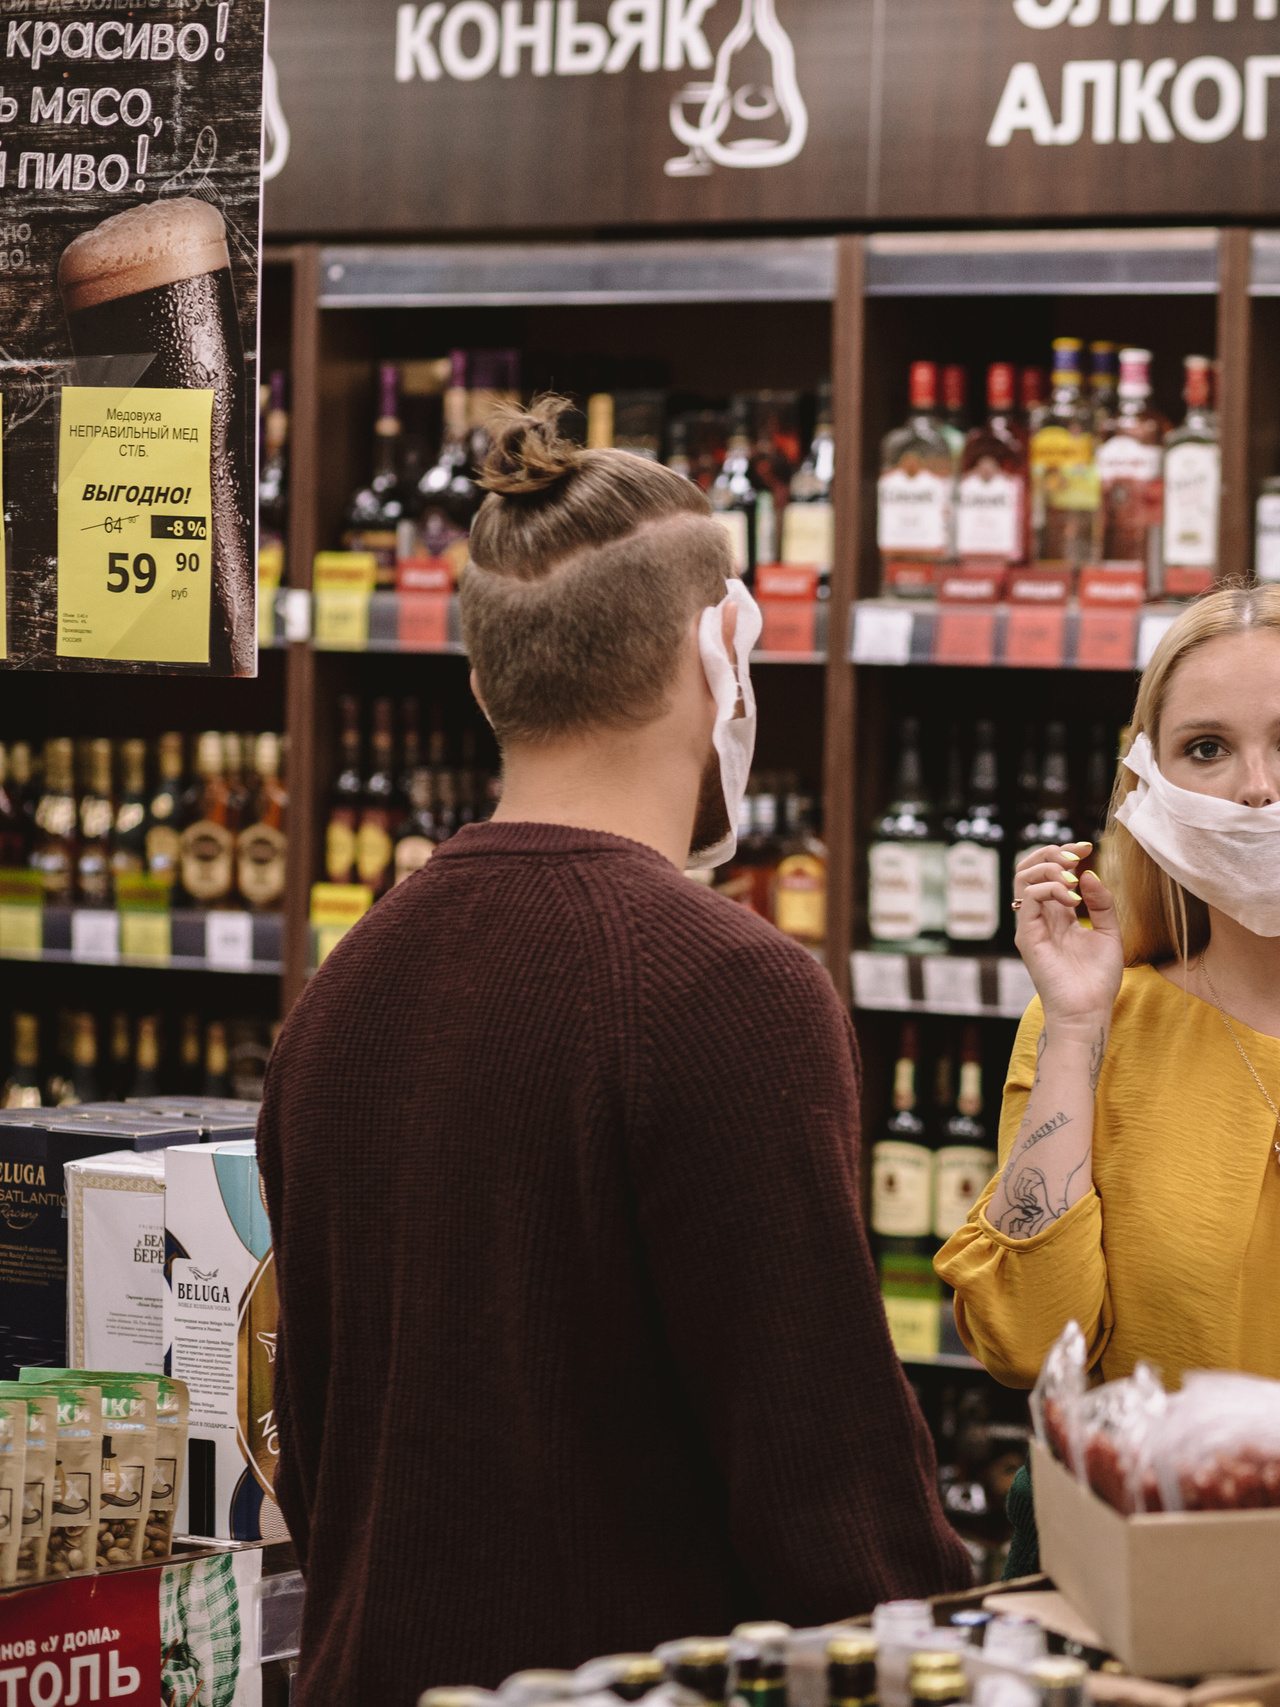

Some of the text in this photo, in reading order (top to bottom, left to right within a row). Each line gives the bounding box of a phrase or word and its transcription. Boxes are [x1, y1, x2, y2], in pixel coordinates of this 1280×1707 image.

[6, 2, 230, 70] красиво!
[395, 0, 716, 82] КОНЬЯК
[30, 86, 164, 138] мясо,
[18, 134, 150, 194] пиво!
[106, 408, 162, 424] Медовуха
[69, 424, 199, 443] НЕПРАВИЛЬНЫЙ МЕД
[118, 444, 149, 458] СТ/Б.
[81, 484, 192, 507] ВЫГОДНО!
[104, 517, 123, 534] 64
[106, 552, 201, 594] 59 90
[171, 588, 188, 600] руб
[178, 1282, 230, 1303] BELUGA
[62, 1626, 121, 1653] ДОМА»
[0, 1649, 141, 1707] ТОЛЬ
